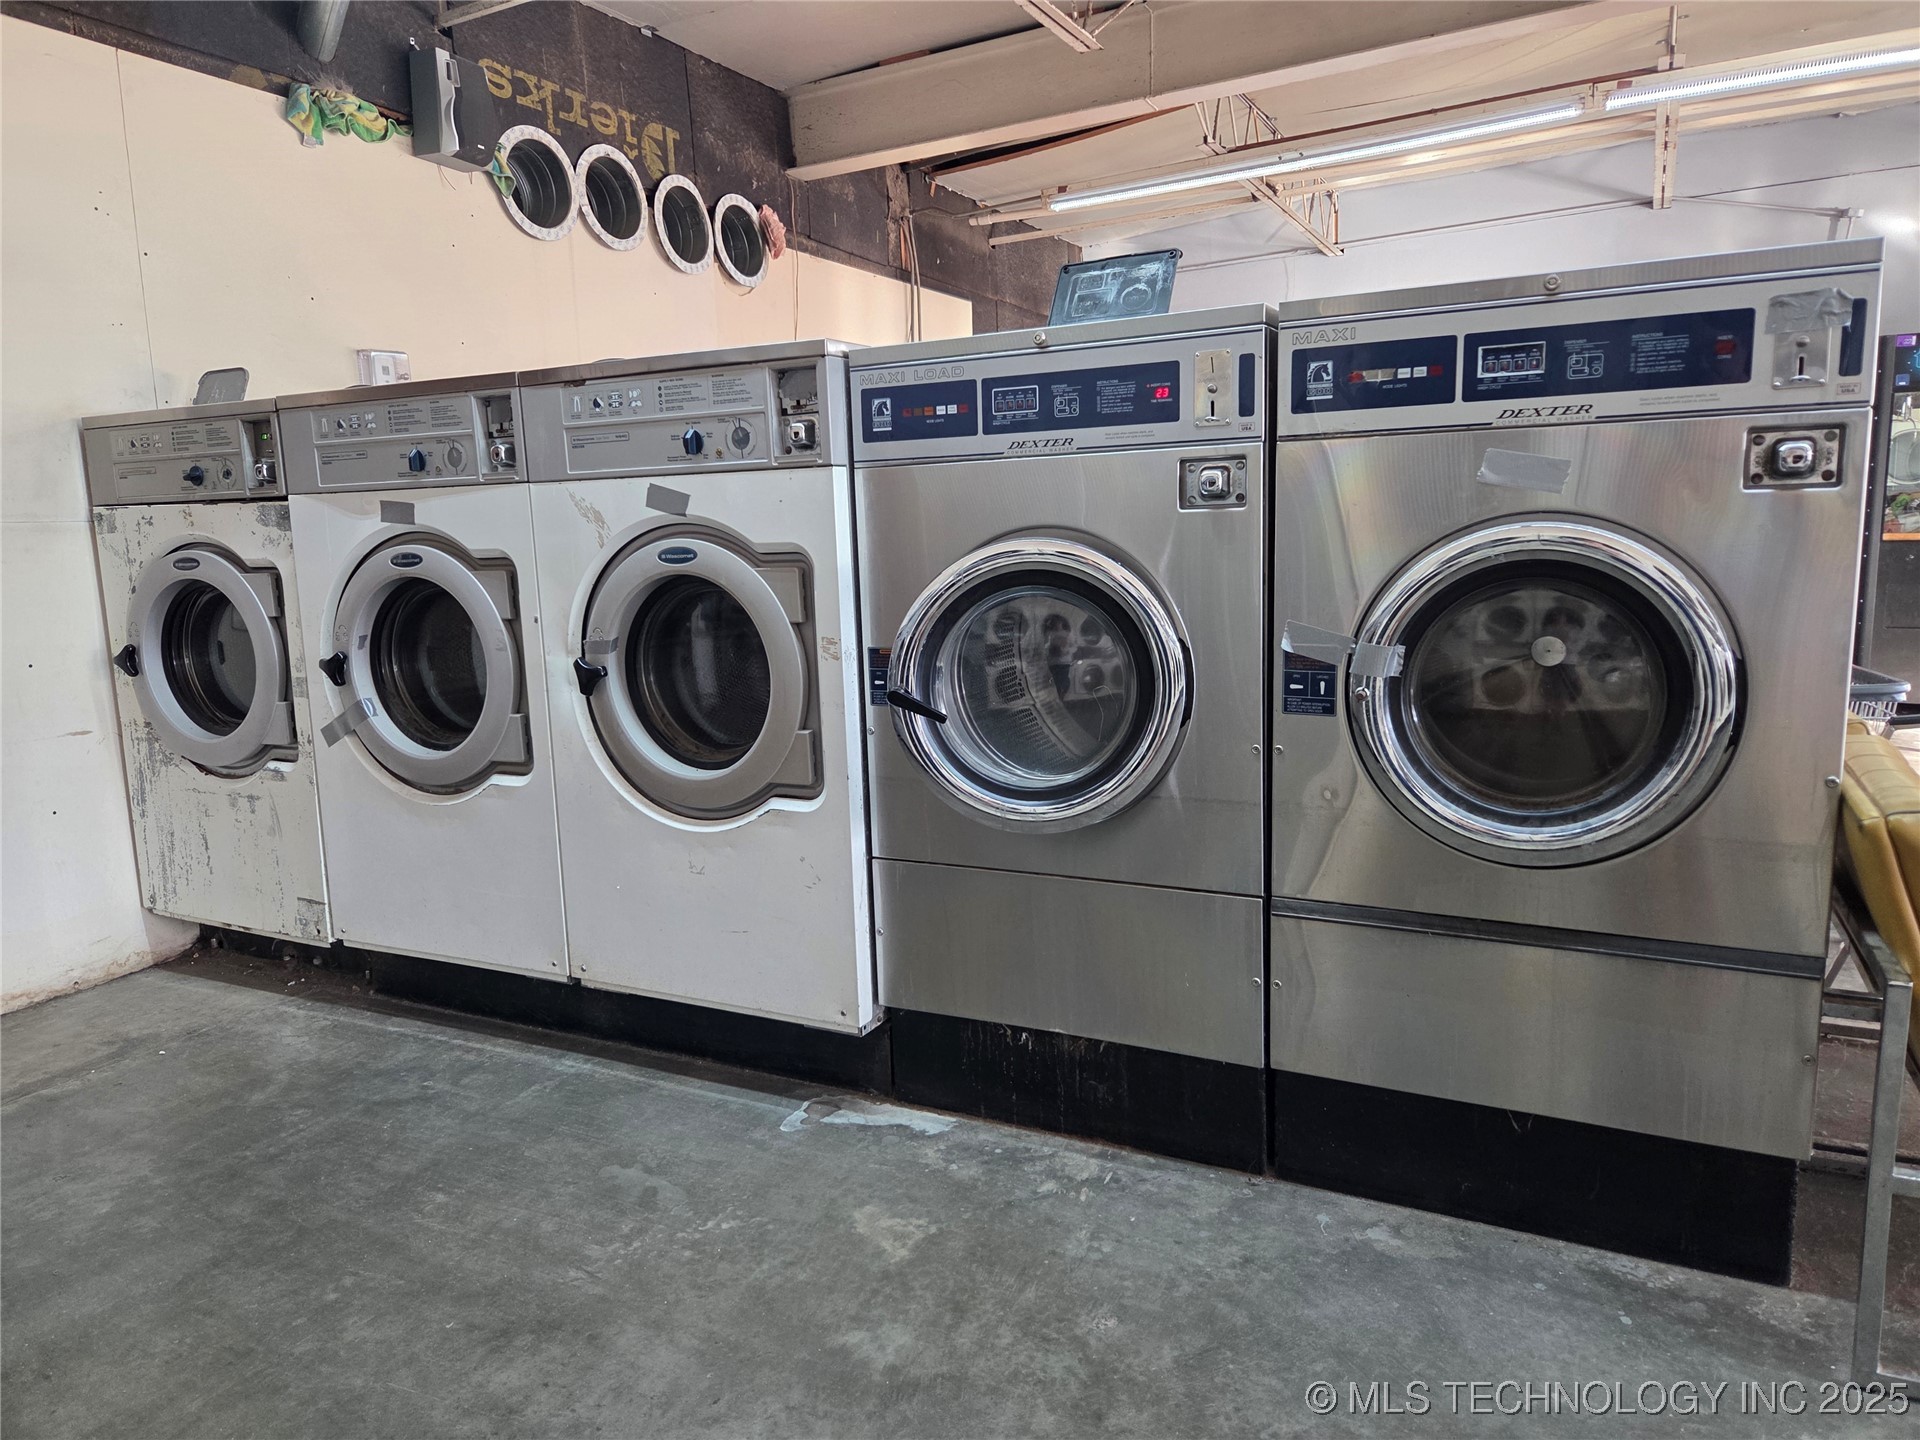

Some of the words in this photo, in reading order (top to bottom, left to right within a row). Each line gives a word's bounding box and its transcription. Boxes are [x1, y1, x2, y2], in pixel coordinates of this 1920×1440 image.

[1292, 326, 1356, 345] MAXI
[860, 370, 905, 386] MAXI
[913, 366, 965, 382] LOAD
[1155, 386, 1170, 398] 23
[1496, 404, 1593, 420] DEXTER
[1007, 437, 1074, 450] DEXTER
